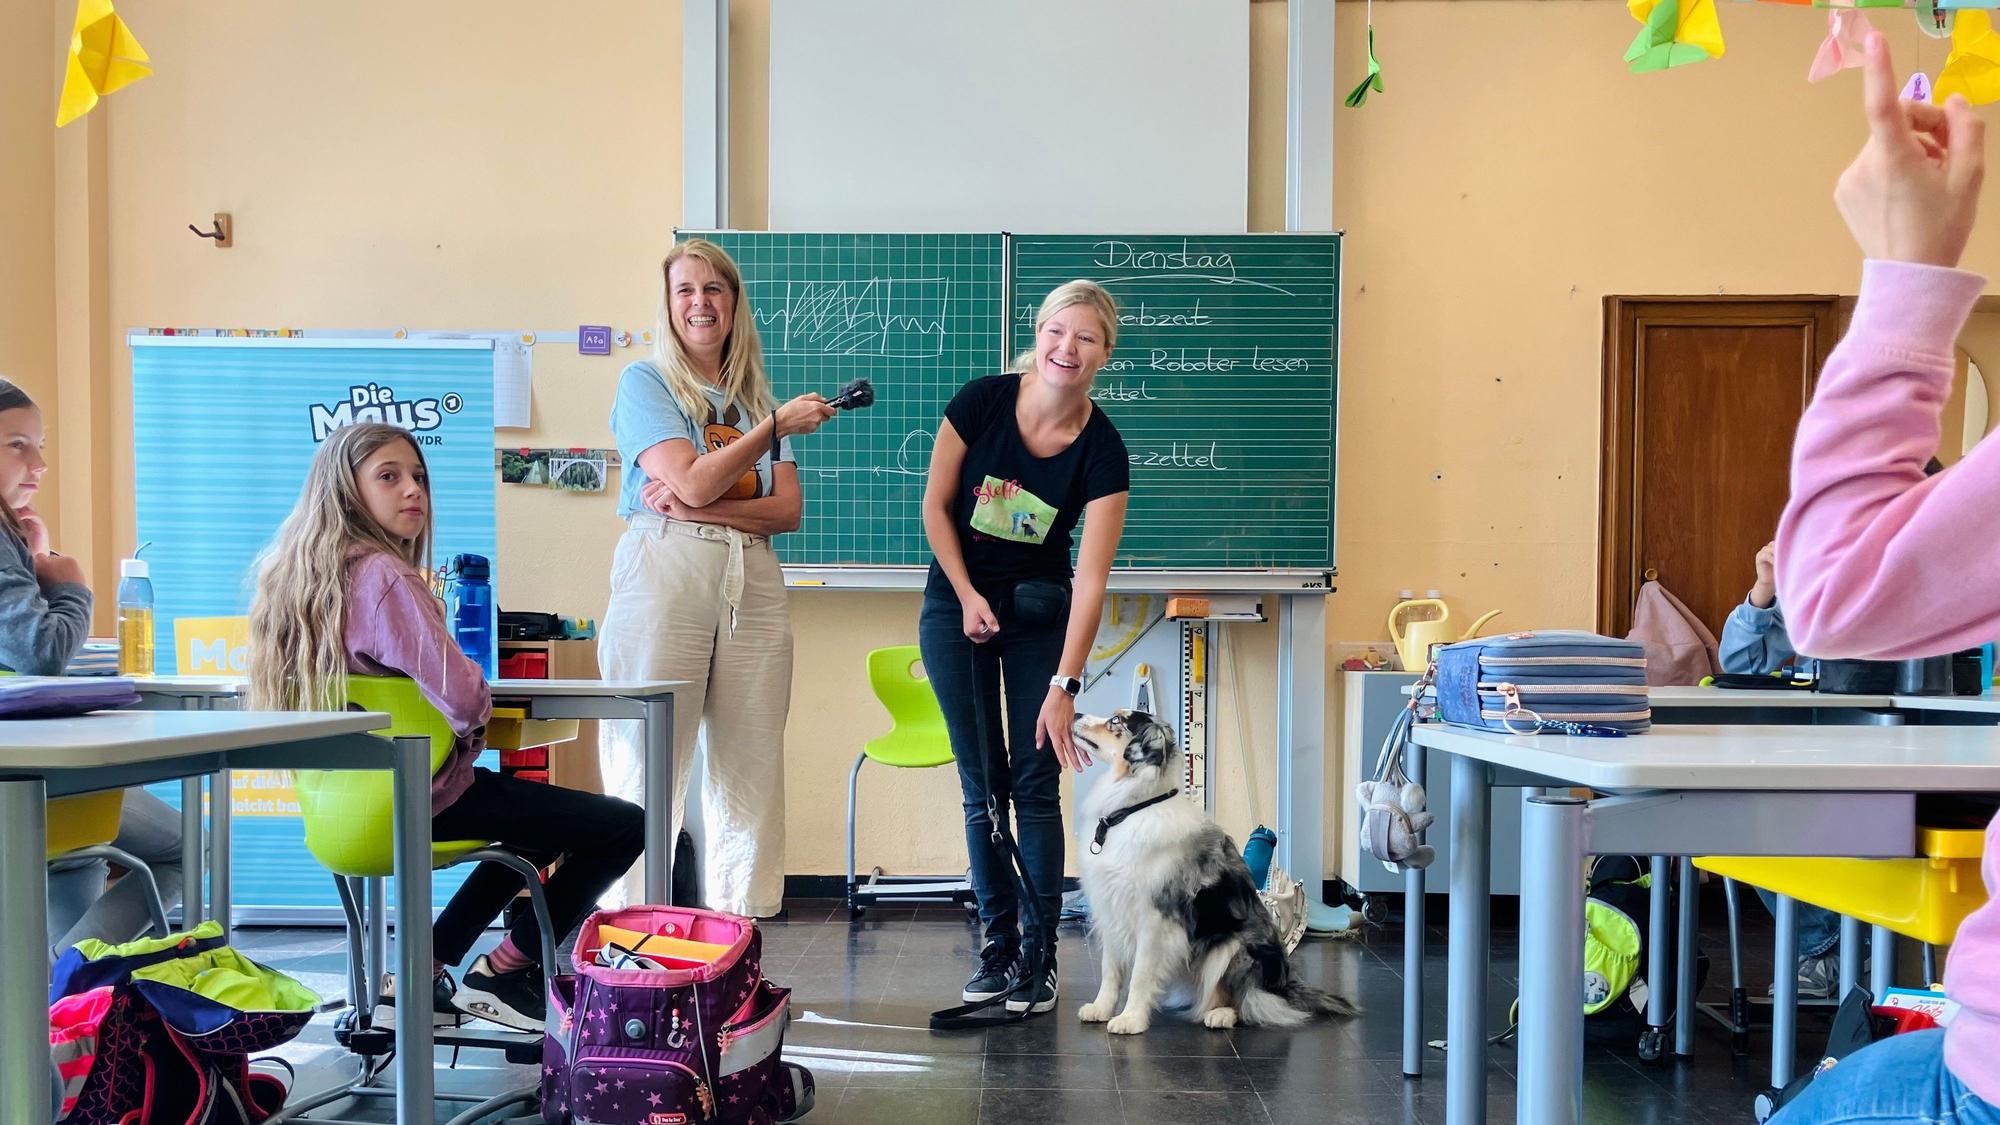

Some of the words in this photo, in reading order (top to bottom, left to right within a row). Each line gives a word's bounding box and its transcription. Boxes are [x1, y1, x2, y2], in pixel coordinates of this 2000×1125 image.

[1093, 237, 1236, 285] Dienstag
[1117, 297, 1213, 327] eibzeit
[1150, 347, 1241, 373] Roboter
[1252, 344, 1310, 373] lesen
[351, 383, 393, 408] Die
[1128, 441, 1228, 471] ezettel
[973, 479, 1023, 505] Steffi
